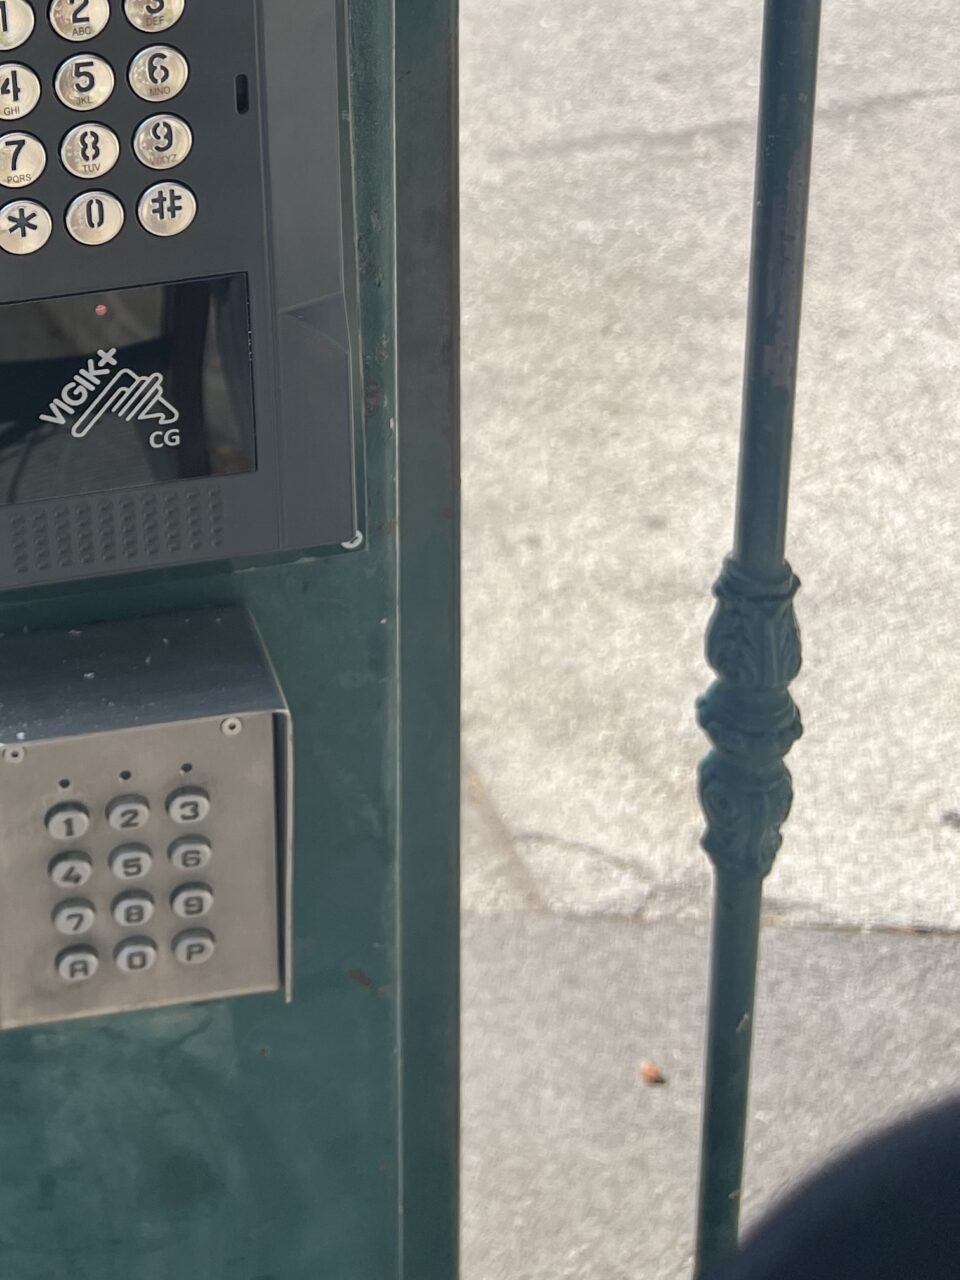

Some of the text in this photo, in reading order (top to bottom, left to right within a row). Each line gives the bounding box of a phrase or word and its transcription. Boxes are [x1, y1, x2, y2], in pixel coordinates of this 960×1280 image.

[72, 26, 92, 36] ABC
[0, 52, 169, 102] 4 5 6
[3, 105, 21, 117] GHI
[5, 121, 173, 171] 7 8 9
[86, 198, 104, 228] 0
[148, 428, 180, 449] CG
[63, 800, 199, 837] 1 2 3
[61, 849, 201, 885] 4 5 6
[65, 896, 203, 931] 7 8 9
[69, 959, 88, 978] A
[186, 942, 205, 961] P
